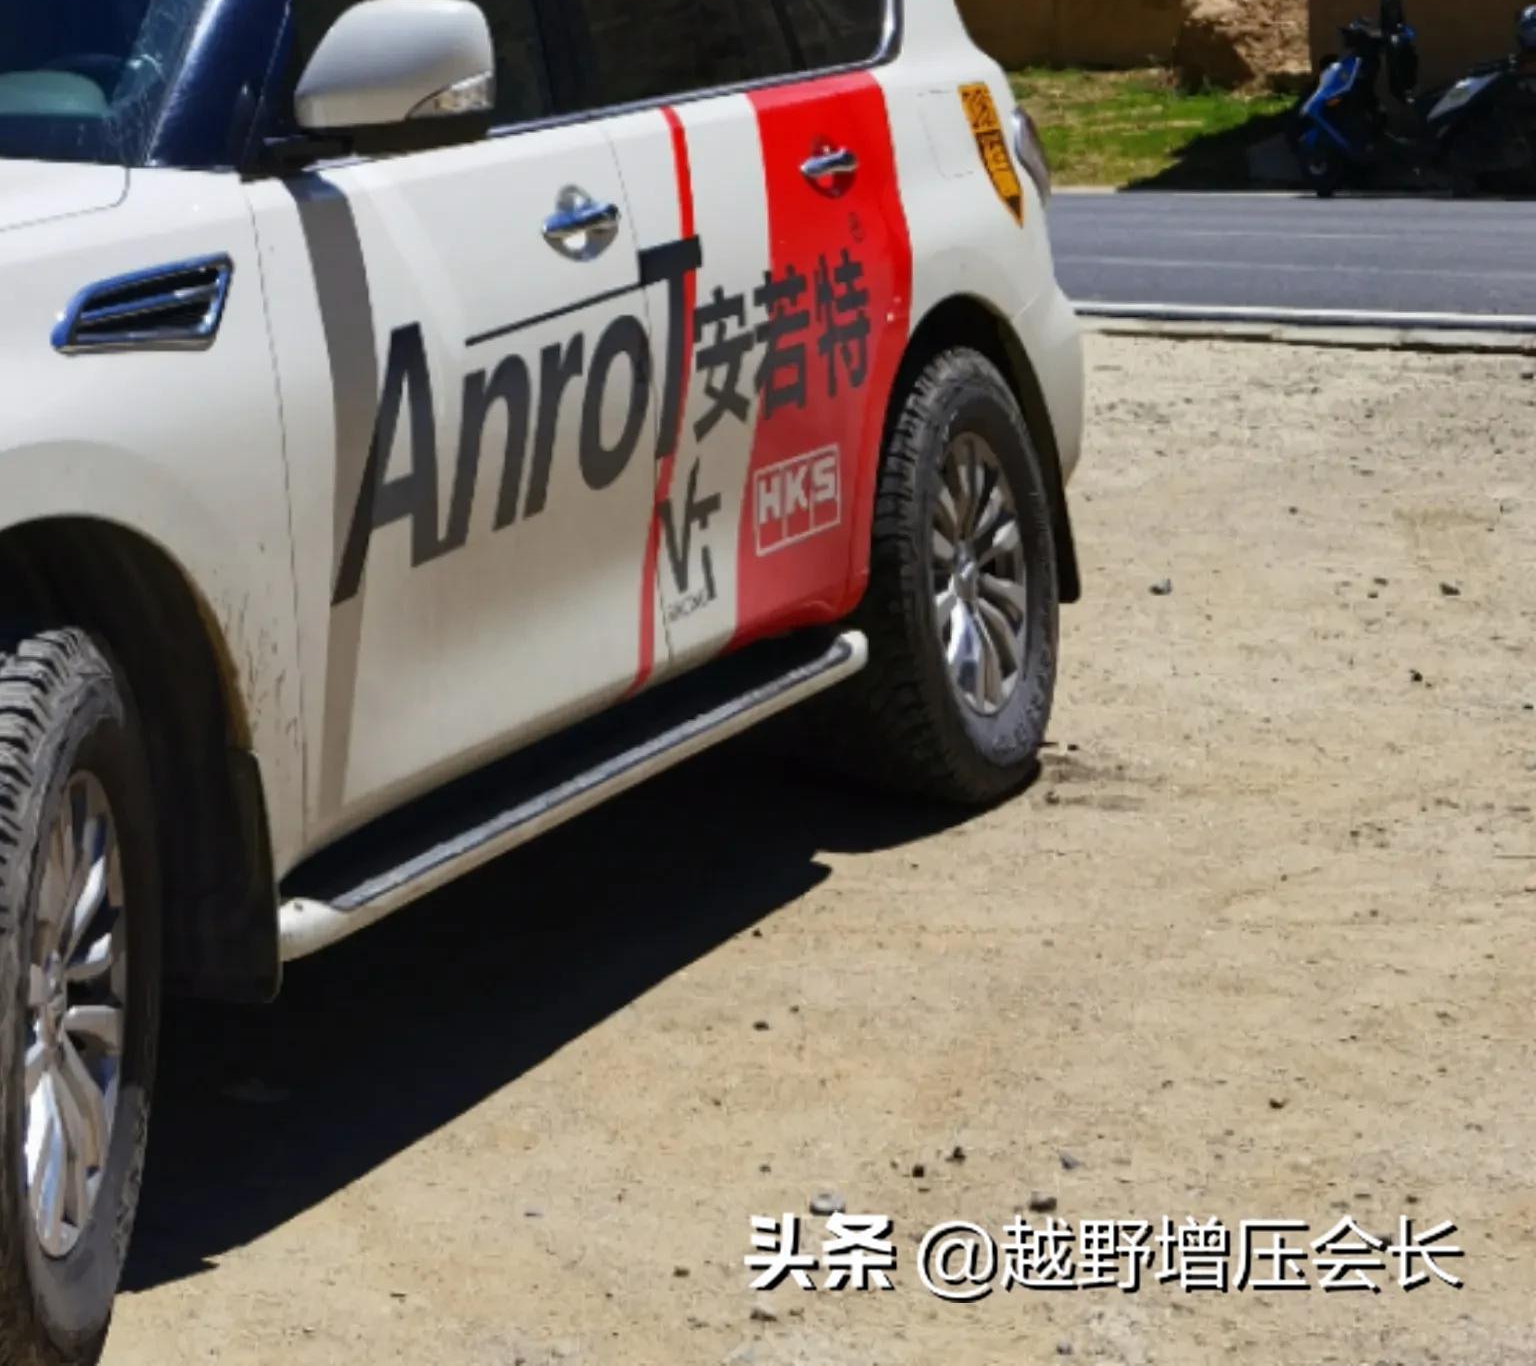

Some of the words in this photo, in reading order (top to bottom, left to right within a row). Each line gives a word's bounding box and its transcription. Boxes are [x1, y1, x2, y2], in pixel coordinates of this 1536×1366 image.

[693, 249, 870, 443] 安若特
[757, 454, 838, 528] HKS
